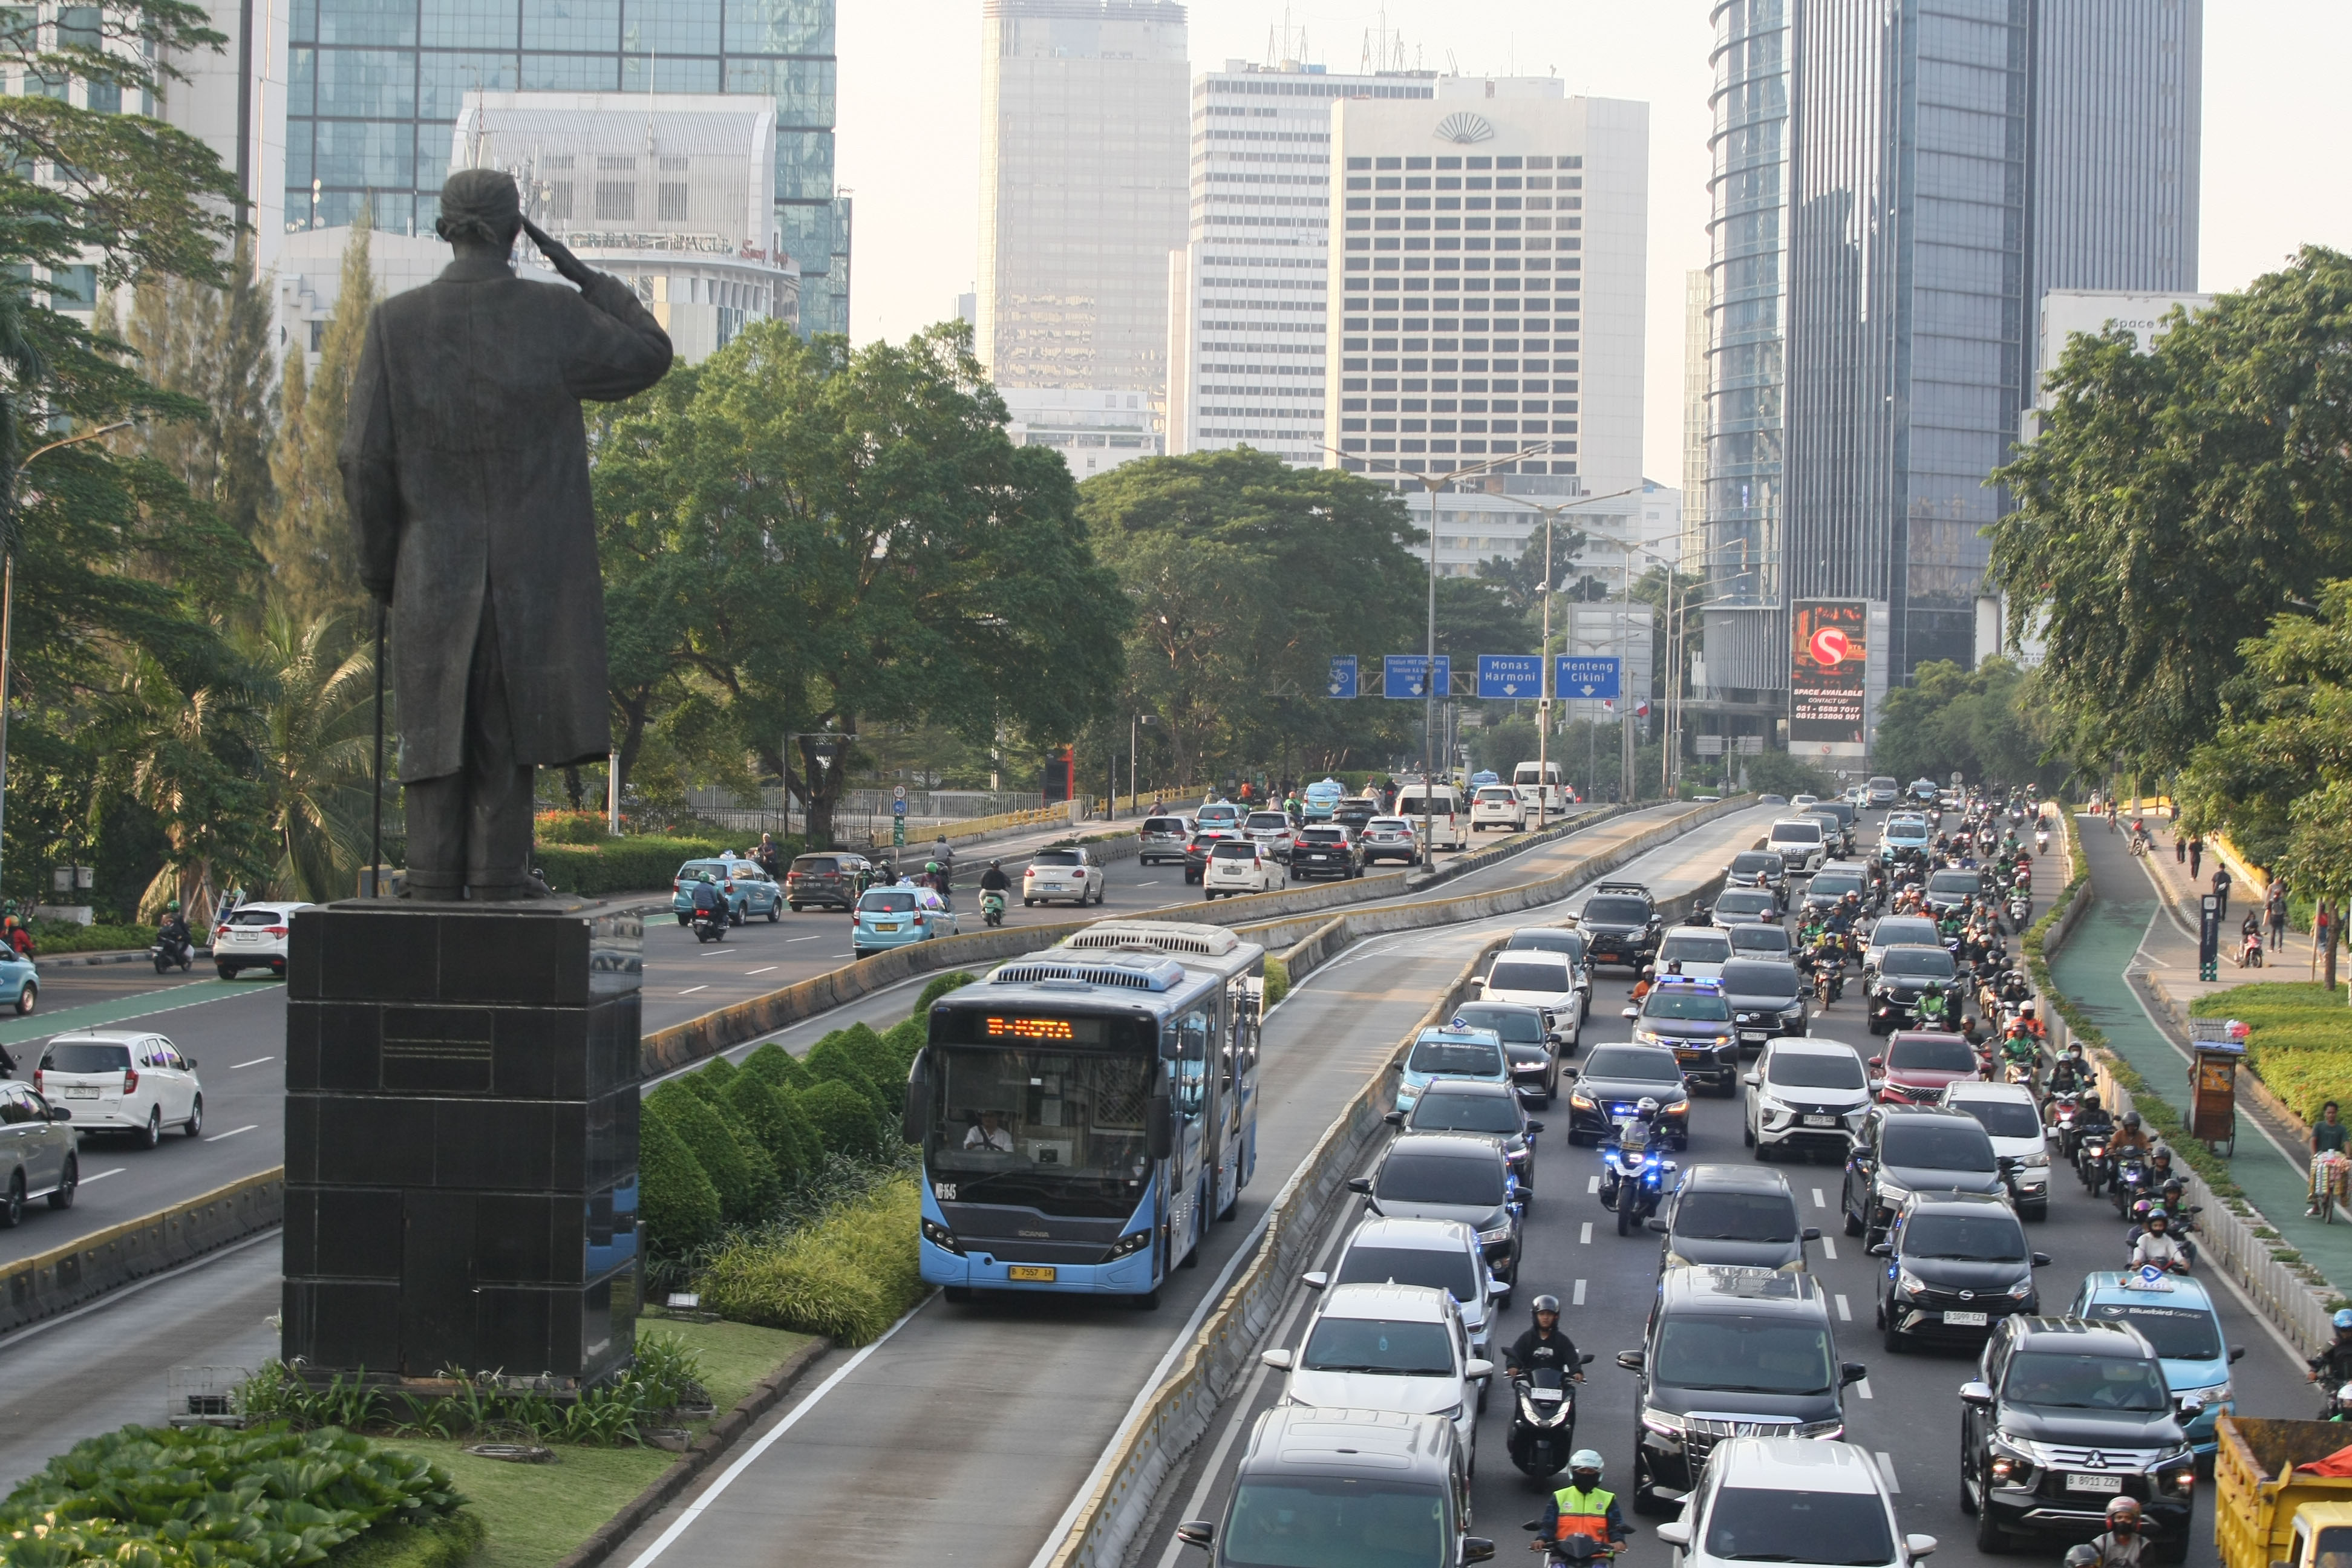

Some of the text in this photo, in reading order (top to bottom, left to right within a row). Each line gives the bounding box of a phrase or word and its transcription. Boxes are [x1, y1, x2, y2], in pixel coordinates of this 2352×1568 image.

[2112, 318, 2154, 330] Space
[1333, 658, 1354, 667] Sepeda
[1491, 661, 1529, 670] Monas
[1563, 662, 1613, 673] Menteng
[1485, 672, 1535, 681] Harmoni
[1571, 673, 1605, 682] Cikini
[2129, 1307, 2174, 1316] Bluebird
[2068, 1475, 2074, 1484] B
